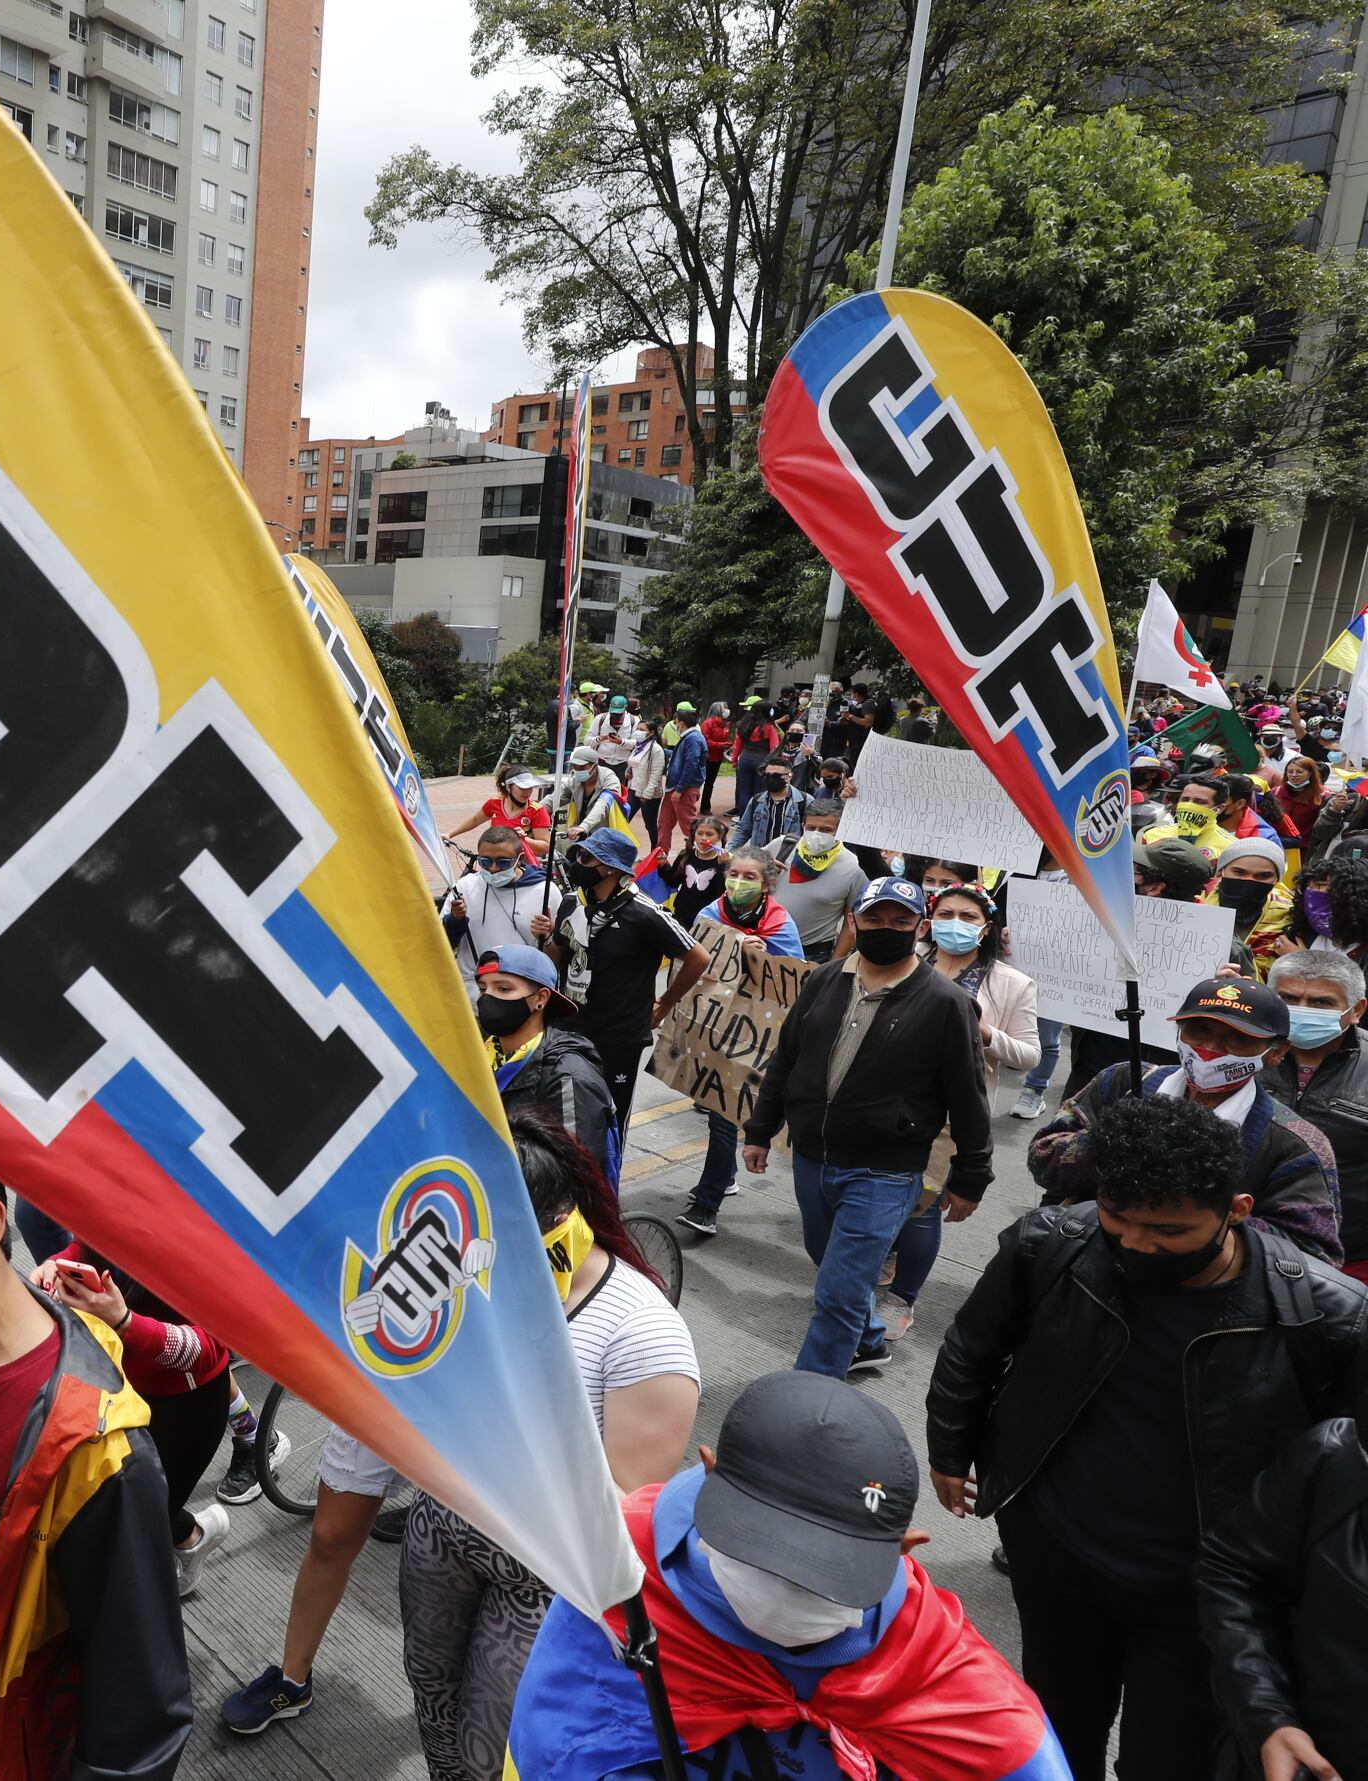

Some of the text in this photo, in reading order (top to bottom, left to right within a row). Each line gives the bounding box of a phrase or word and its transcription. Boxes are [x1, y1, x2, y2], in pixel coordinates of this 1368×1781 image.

[829, 333, 1109, 774] CUT
[846, 804, 884, 826] SOBRA
[888, 809, 928, 833] VALOR
[933, 815, 964, 836] PARA
[961, 800, 1005, 822] JOVEN
[843, 821, 851, 841] Y
[860, 823, 879, 846] MIL
[883, 830, 966, 860] MUERTES
[1050, 883, 1073, 904] POR
[1011, 901, 1054, 928] SEAMOS
[1150, 923, 1221, 957] IGUALES
[1018, 943, 1096, 979] TOTALMENTE
[1062, 978, 1107, 997] VICTORIA
[690, 1057, 726, 1112] YA
[372, 1222, 465, 1338] CUT
